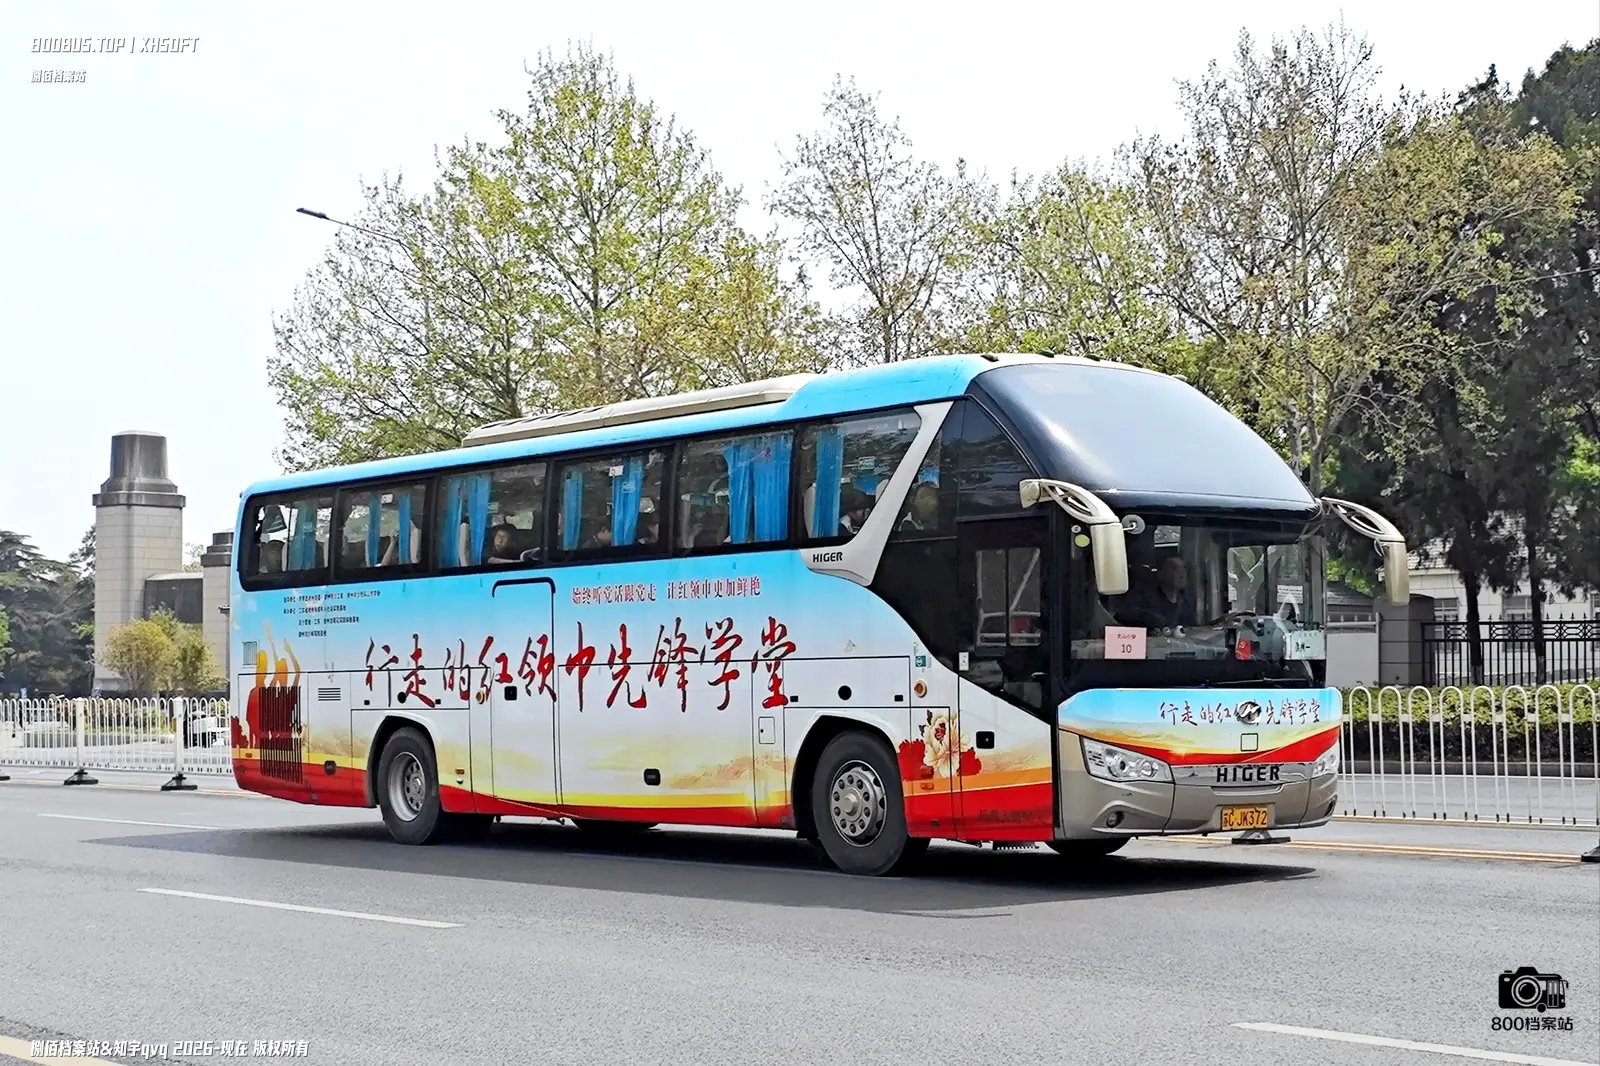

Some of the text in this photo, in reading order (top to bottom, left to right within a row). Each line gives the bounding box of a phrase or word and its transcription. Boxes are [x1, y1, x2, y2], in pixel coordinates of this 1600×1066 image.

[812, 552, 843, 563] HIGER
[572, 576, 761, 604] 始终听党话跟党走 让红领巾更加鲜艳
[1121, 644, 1132, 654] 10
[365, 616, 797, 713] 行走的红领巾先锋学堂
[1159, 698, 1321, 726] 行走的红先锋学堂
[1216, 765, 1280, 783] HIGER
